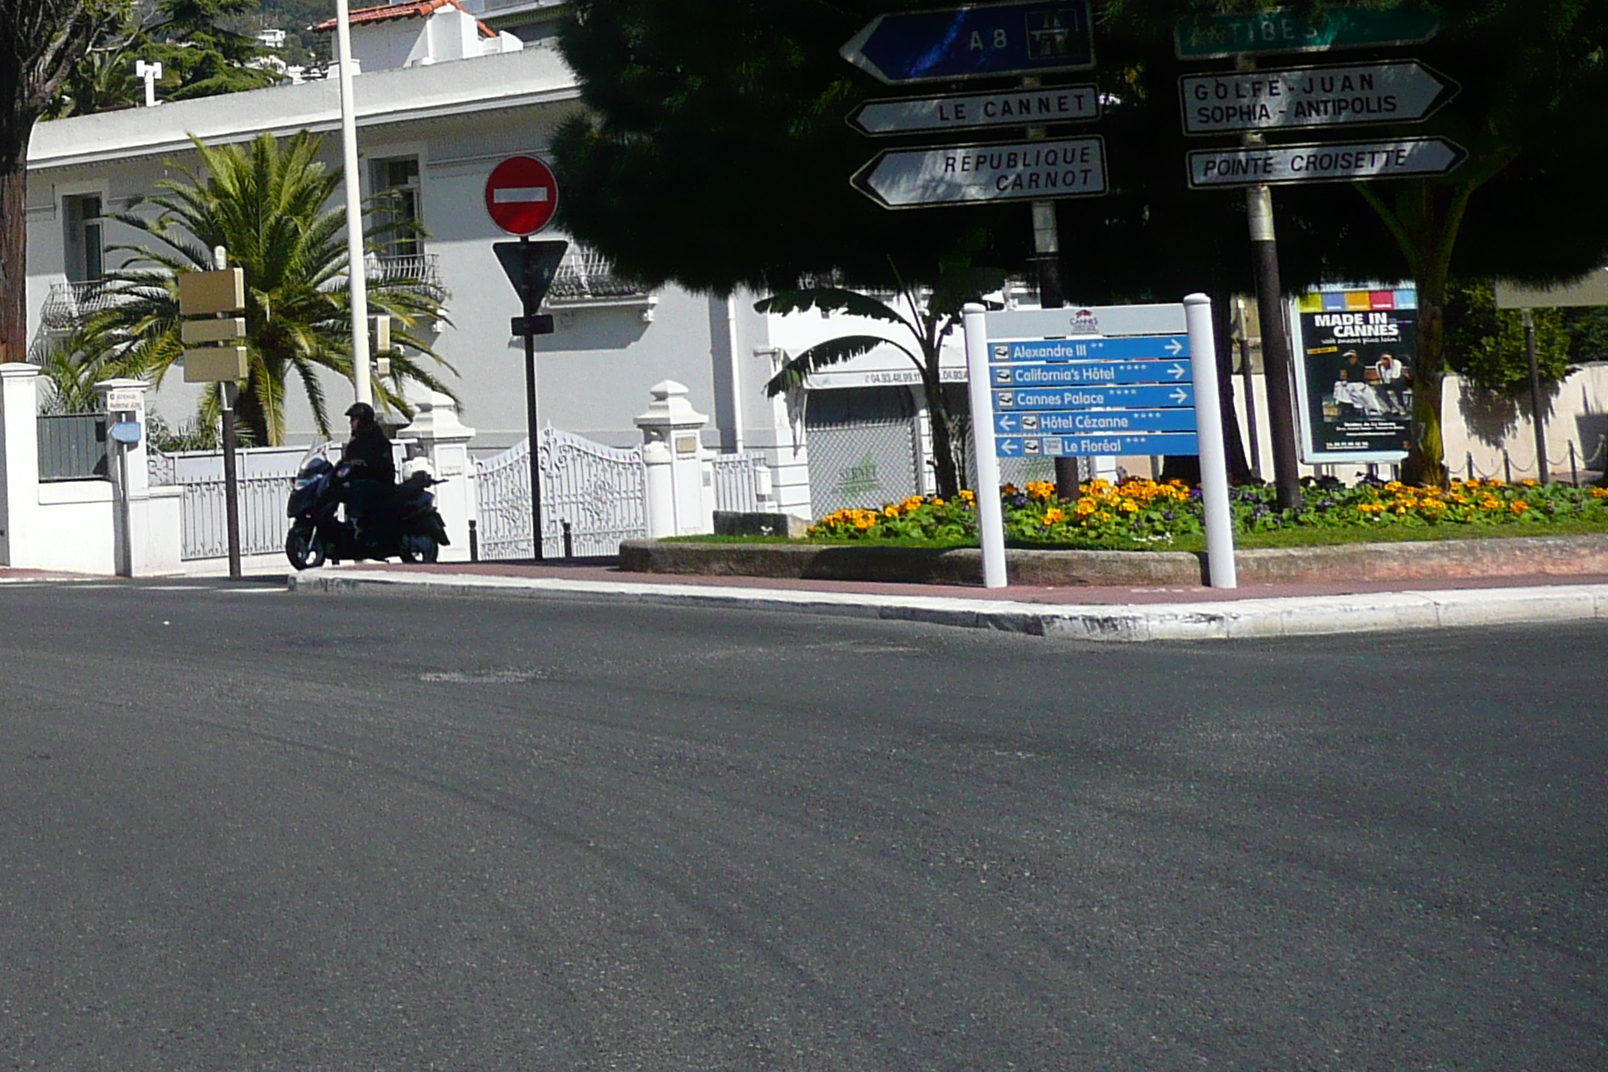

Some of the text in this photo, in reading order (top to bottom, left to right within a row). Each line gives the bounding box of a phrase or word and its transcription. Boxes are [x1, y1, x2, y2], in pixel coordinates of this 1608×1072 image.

[939, 94, 1086, 122] LE CANNET
[1197, 103, 1271, 124] SOPHIA
[1294, 95, 1398, 119] ANTIPOLIS
[1203, 149, 1406, 177] POINTE CROISETTE
[996, 169, 1092, 193] CARNOT
[1314, 314, 1364, 327] MADE
[1368, 312, 1387, 325] IN
[1333, 324, 1399, 337] CANNES
[1013, 344, 1073, 359] Alexandre
[1015, 367, 1115, 382] California's Hôtel
[1017, 391, 1104, 406] Cannes Palace
[1041, 414, 1128, 429] Hôtel Cézanne
[1064, 440, 1079, 452] Le
[1082, 439, 1121, 452] Floréal
